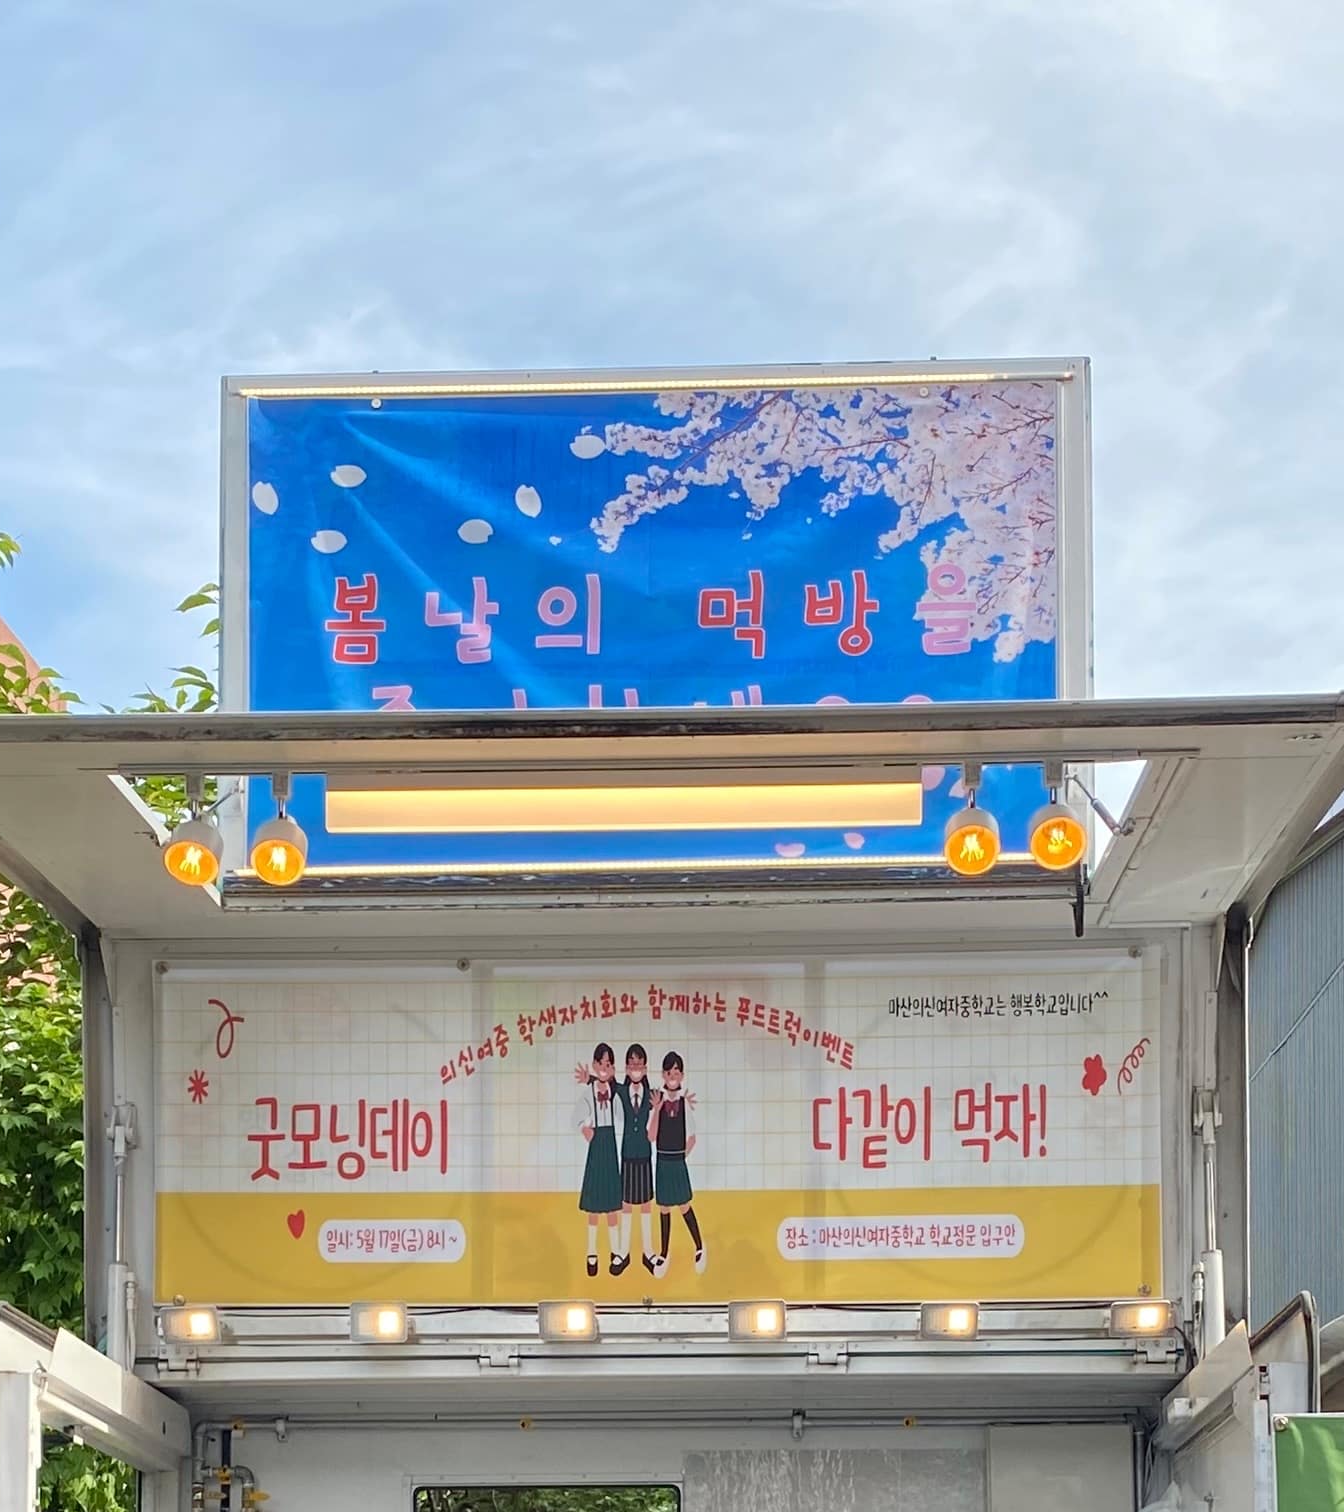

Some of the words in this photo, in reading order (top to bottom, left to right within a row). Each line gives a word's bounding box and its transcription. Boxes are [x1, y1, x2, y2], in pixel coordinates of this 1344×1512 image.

[324, 572, 602, 665] 봄날의
[697, 562, 976, 660] 먹방을
[440, 1023, 510, 1085] 의신여중
[517, 989, 639, 1046] 학생자치회와
[648, 984, 727, 1023] 함께하는
[888, 994, 1006, 1018] 마산의신여자중학교는
[247, 1097, 448, 1181] 굿모닝데이
[812, 1084, 932, 1169] 다같이
[954, 1082, 1049, 1162] 먹자!
[326, 1229, 353, 1253] 일시:
[357, 1229, 375, 1253] 5월
[379, 1229, 424, 1253] 17일(금)
[427, 1229, 445, 1251] 8시
[819, 1225, 925, 1249] 마산의신여자중학교
[930, 1224, 976, 1248] 학교정문
